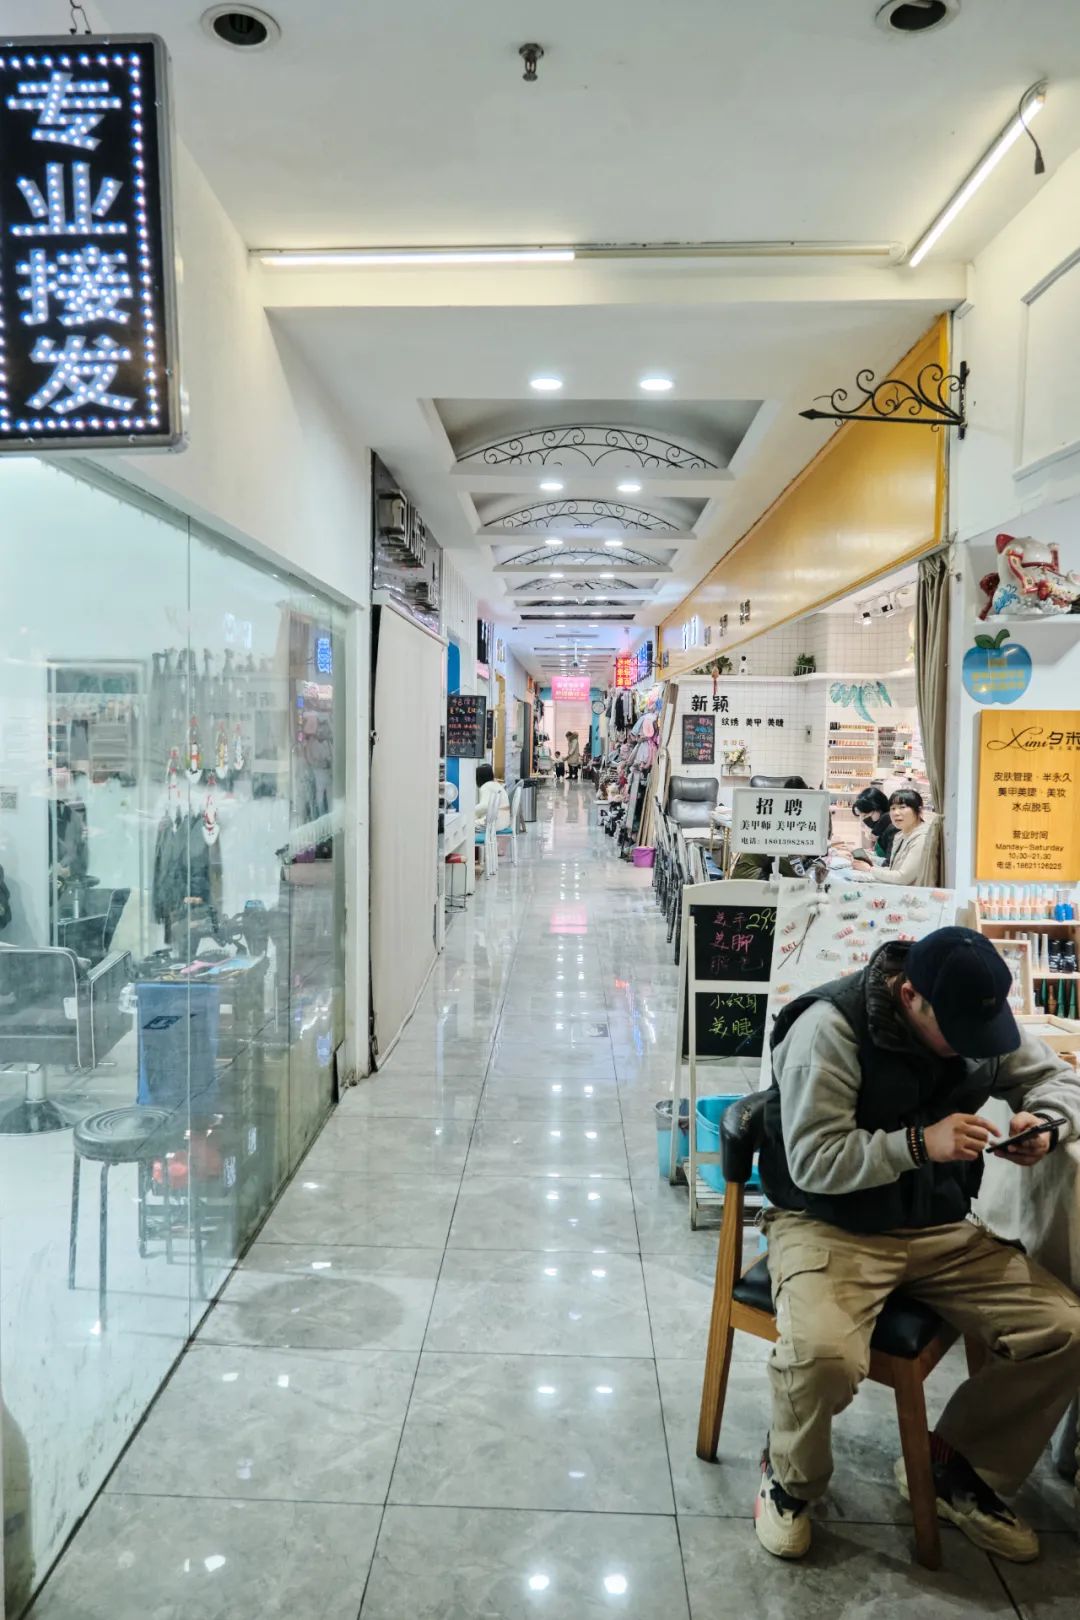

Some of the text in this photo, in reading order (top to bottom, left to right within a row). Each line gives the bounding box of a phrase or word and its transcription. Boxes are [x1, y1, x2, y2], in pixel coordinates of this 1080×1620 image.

[6, 70, 137, 414] 专业接发
[691, 694, 729, 712] 新颖
[721, 717, 739, 727] 纹绣
[745, 717, 762, 727] 美甲
[756, 797, 803, 816] 招聘
[741, 820, 817, 832] 美甲师 美甲学员
[1012, 830, 1049, 840] 营业时间
